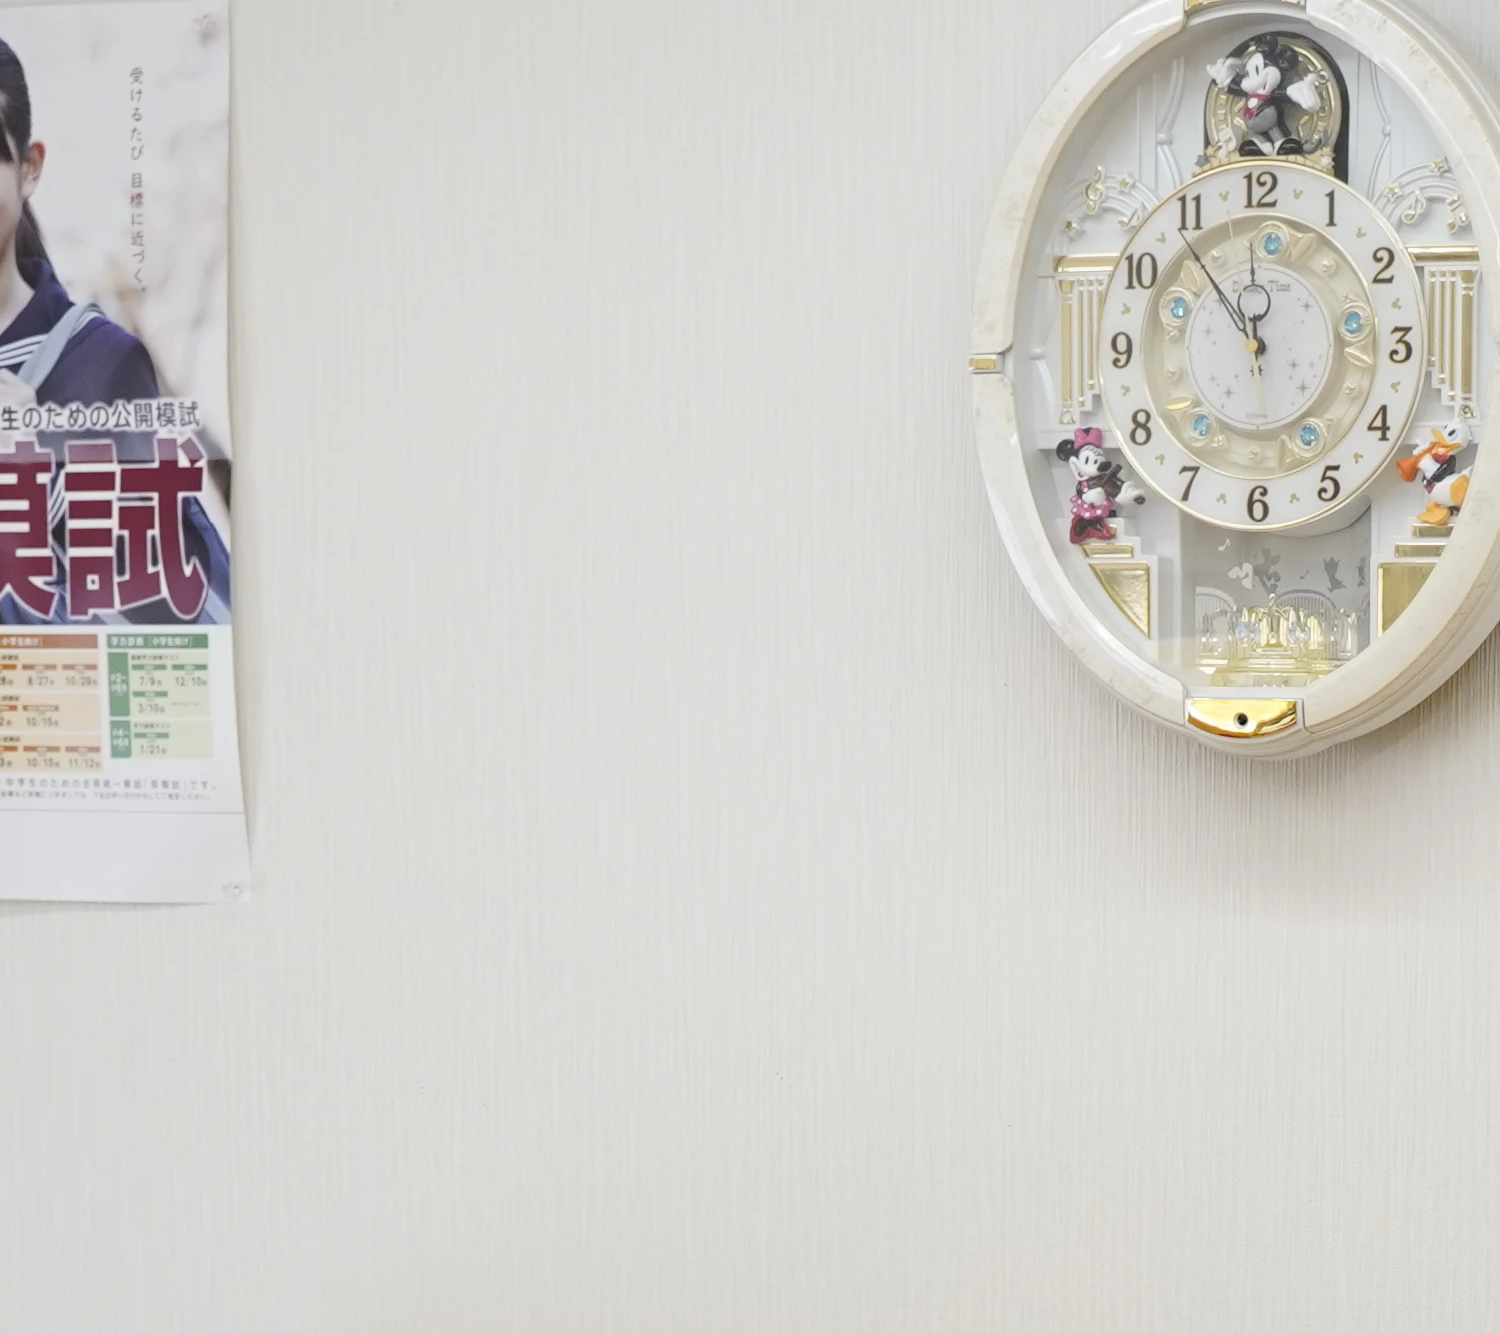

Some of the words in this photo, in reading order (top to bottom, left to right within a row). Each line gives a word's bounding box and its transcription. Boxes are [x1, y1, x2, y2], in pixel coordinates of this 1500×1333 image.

[129, 67, 145, 161] 受けるたび
[1243, 171, 1279, 209] 12
[1324, 190, 1338, 227] 1
[1177, 194, 1203, 231] 11
[1125, 253, 1158, 291] 10
[1372, 247, 1396, 284] 2
[1111, 332, 1133, 369] 9
[1389, 326, 1414, 364] 3
[1130, 409, 1153, 446] 8
[1367, 405, 1391, 443] 4
[1178, 465, 1202, 502] 7
[1317, 465, 1341, 502] 5
[1247, 486, 1269, 523] 6
